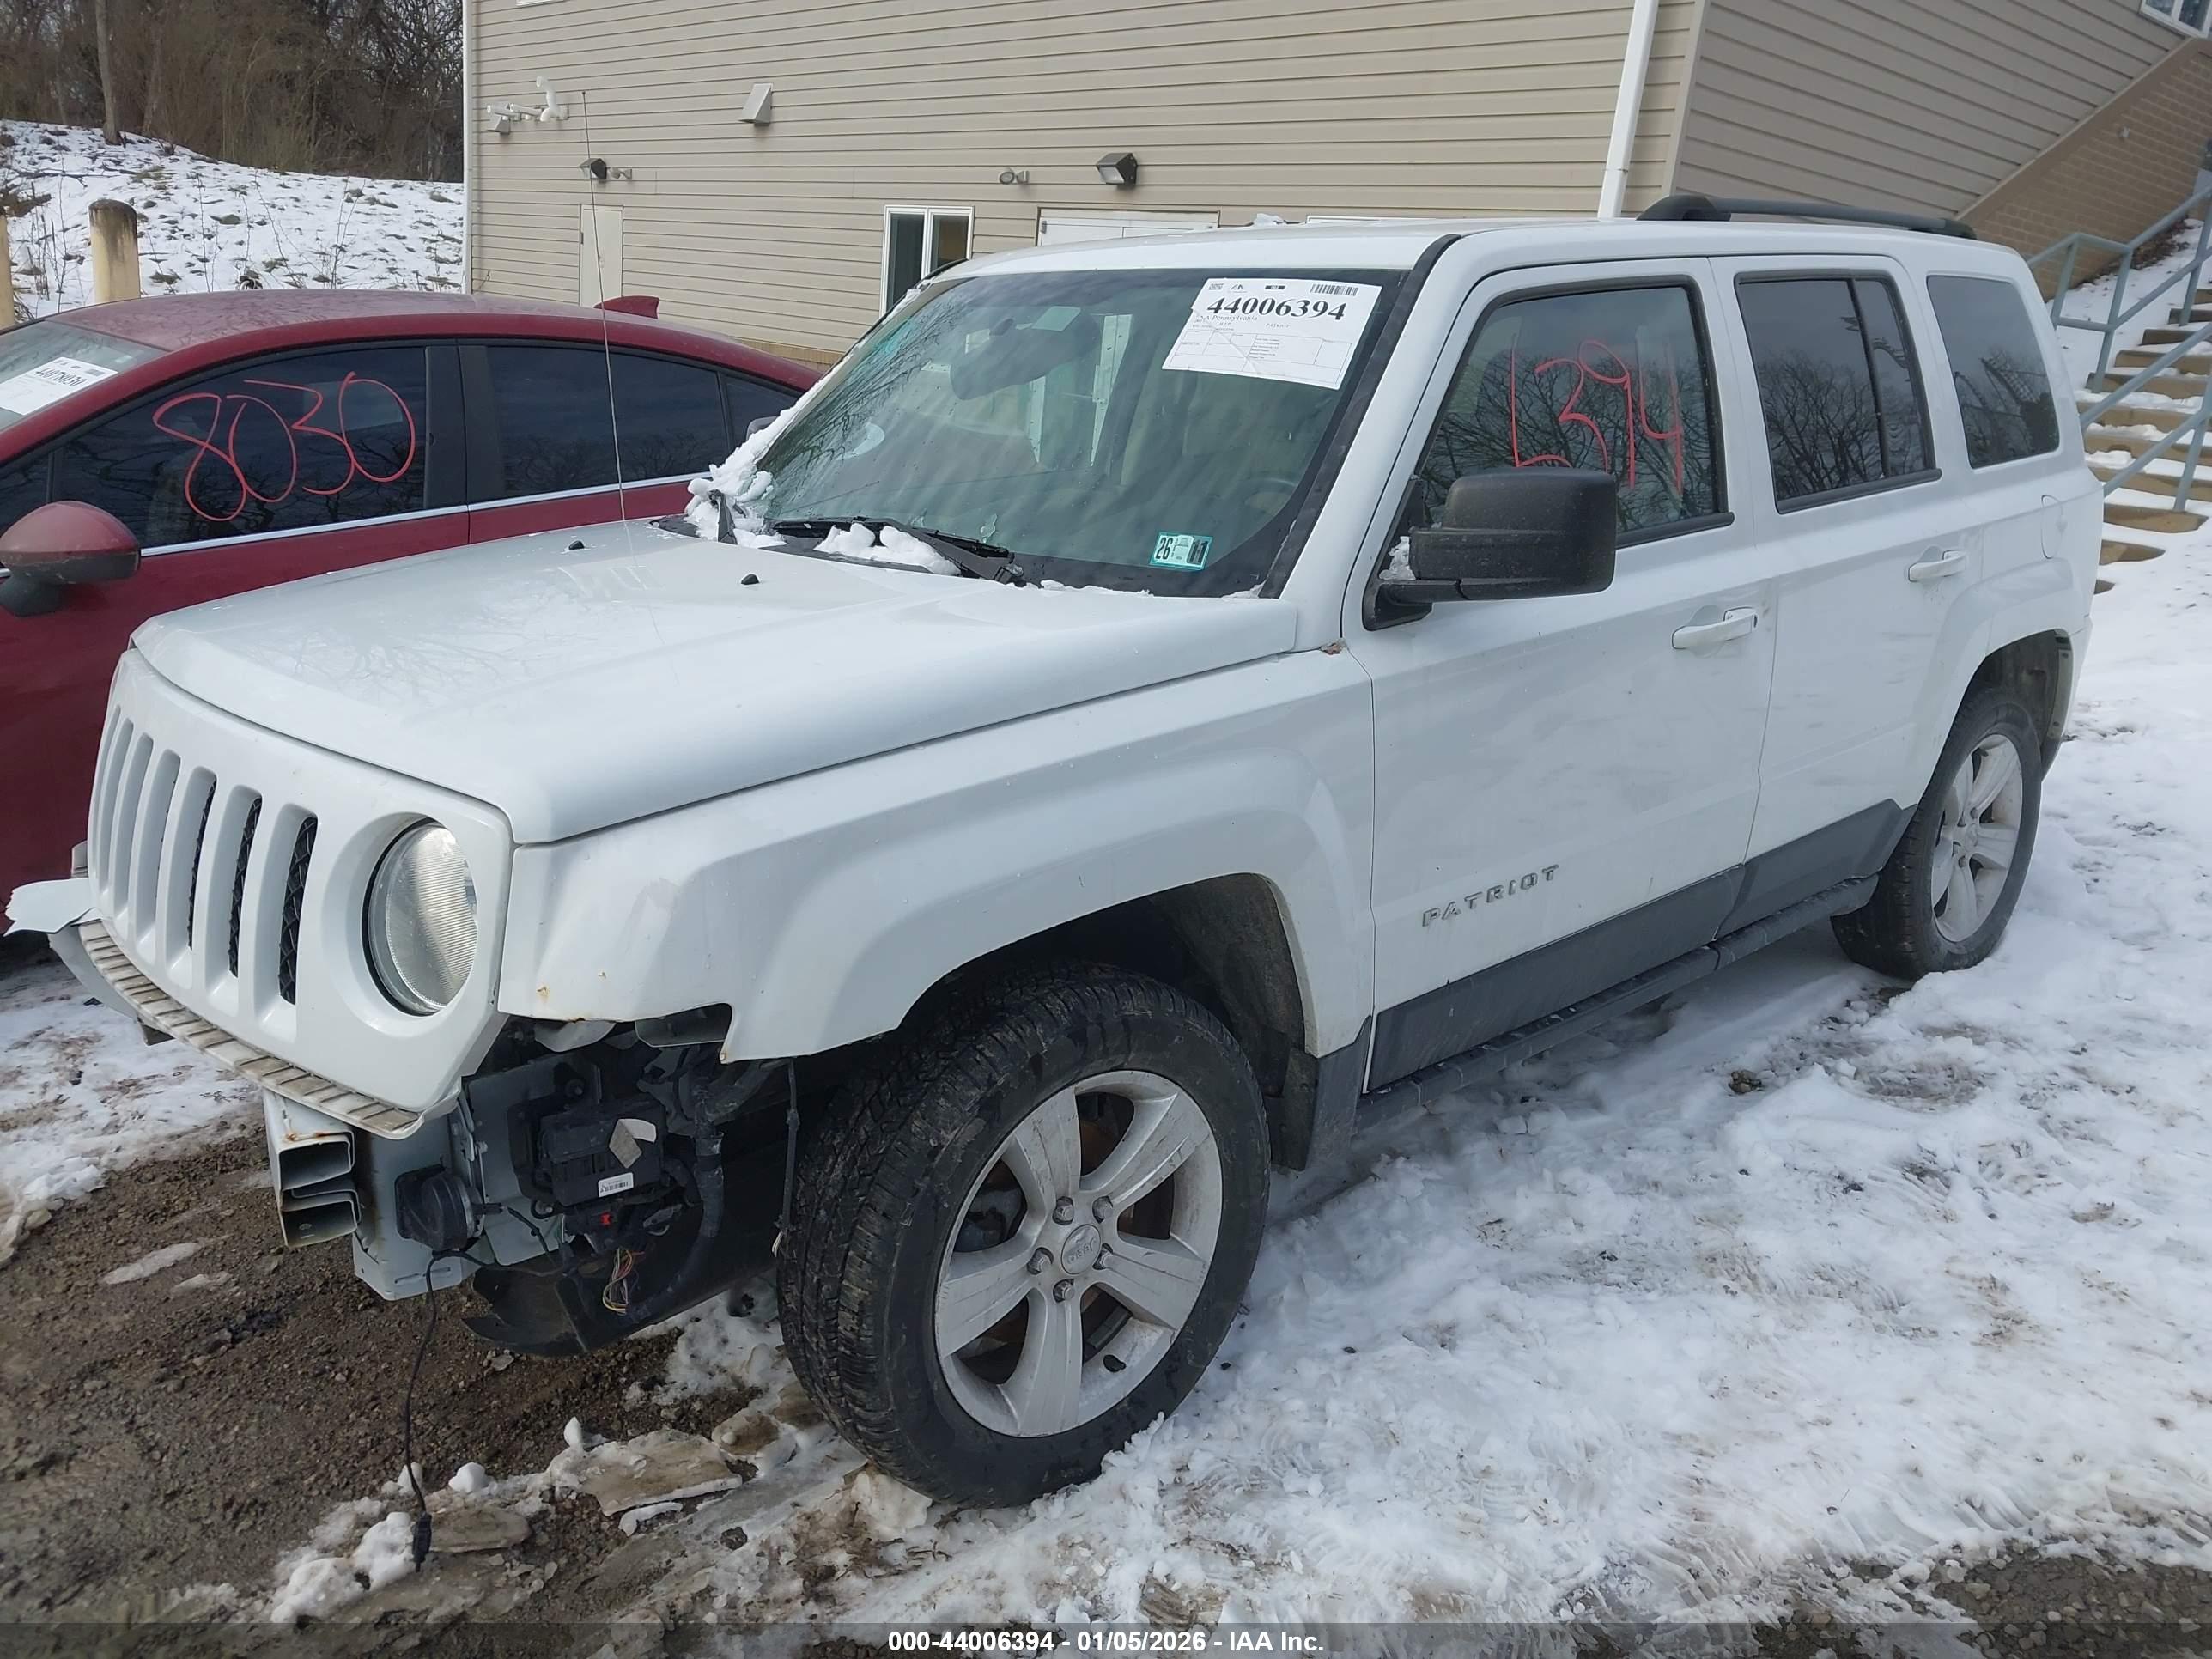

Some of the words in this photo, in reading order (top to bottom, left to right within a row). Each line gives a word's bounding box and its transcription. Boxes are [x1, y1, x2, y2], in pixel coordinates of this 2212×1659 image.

[1207, 297, 1346, 321] 44006394
[152, 371, 416, 522] 8030
[1155, 537, 1174, 560] 26
[1189, 539, 1209, 564] 11
[1421, 864, 1561, 928] PATRIOT
